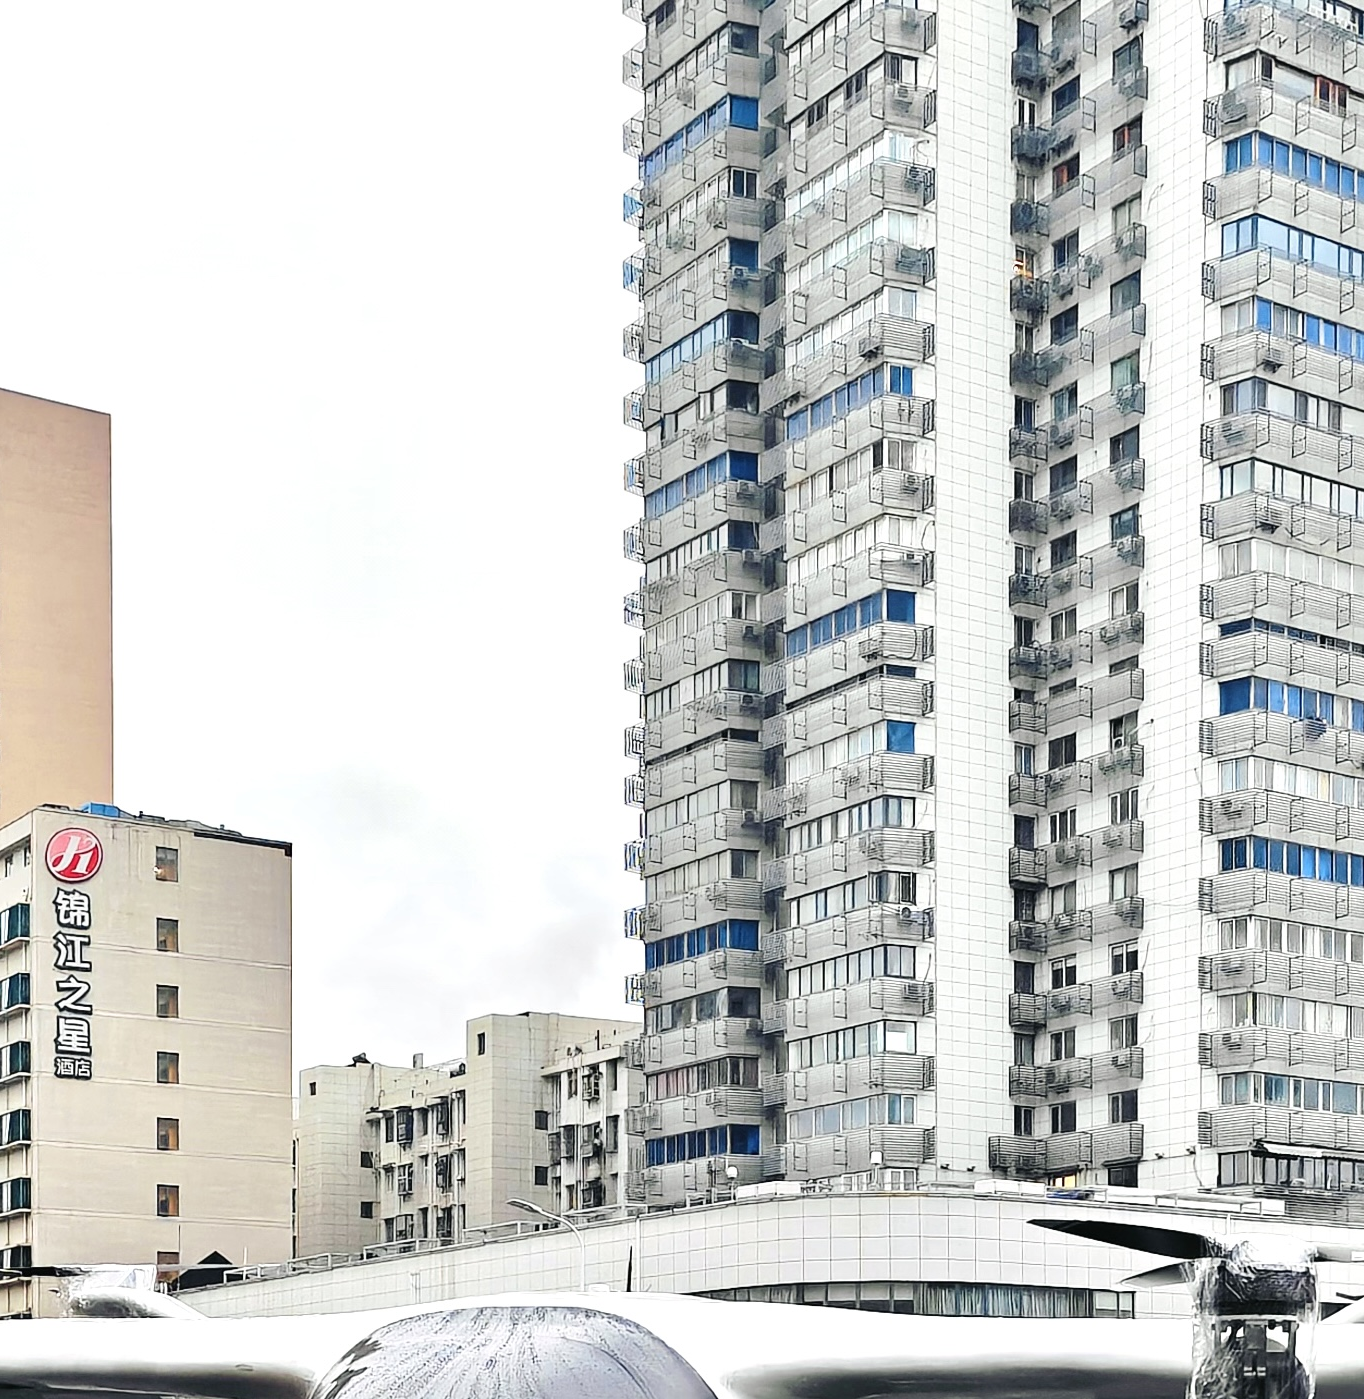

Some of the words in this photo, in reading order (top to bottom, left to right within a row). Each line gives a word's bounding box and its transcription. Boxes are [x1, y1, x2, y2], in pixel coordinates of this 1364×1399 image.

[52, 887, 93, 1055] 锦江之星
[54, 1057, 93, 1080] 酒店
